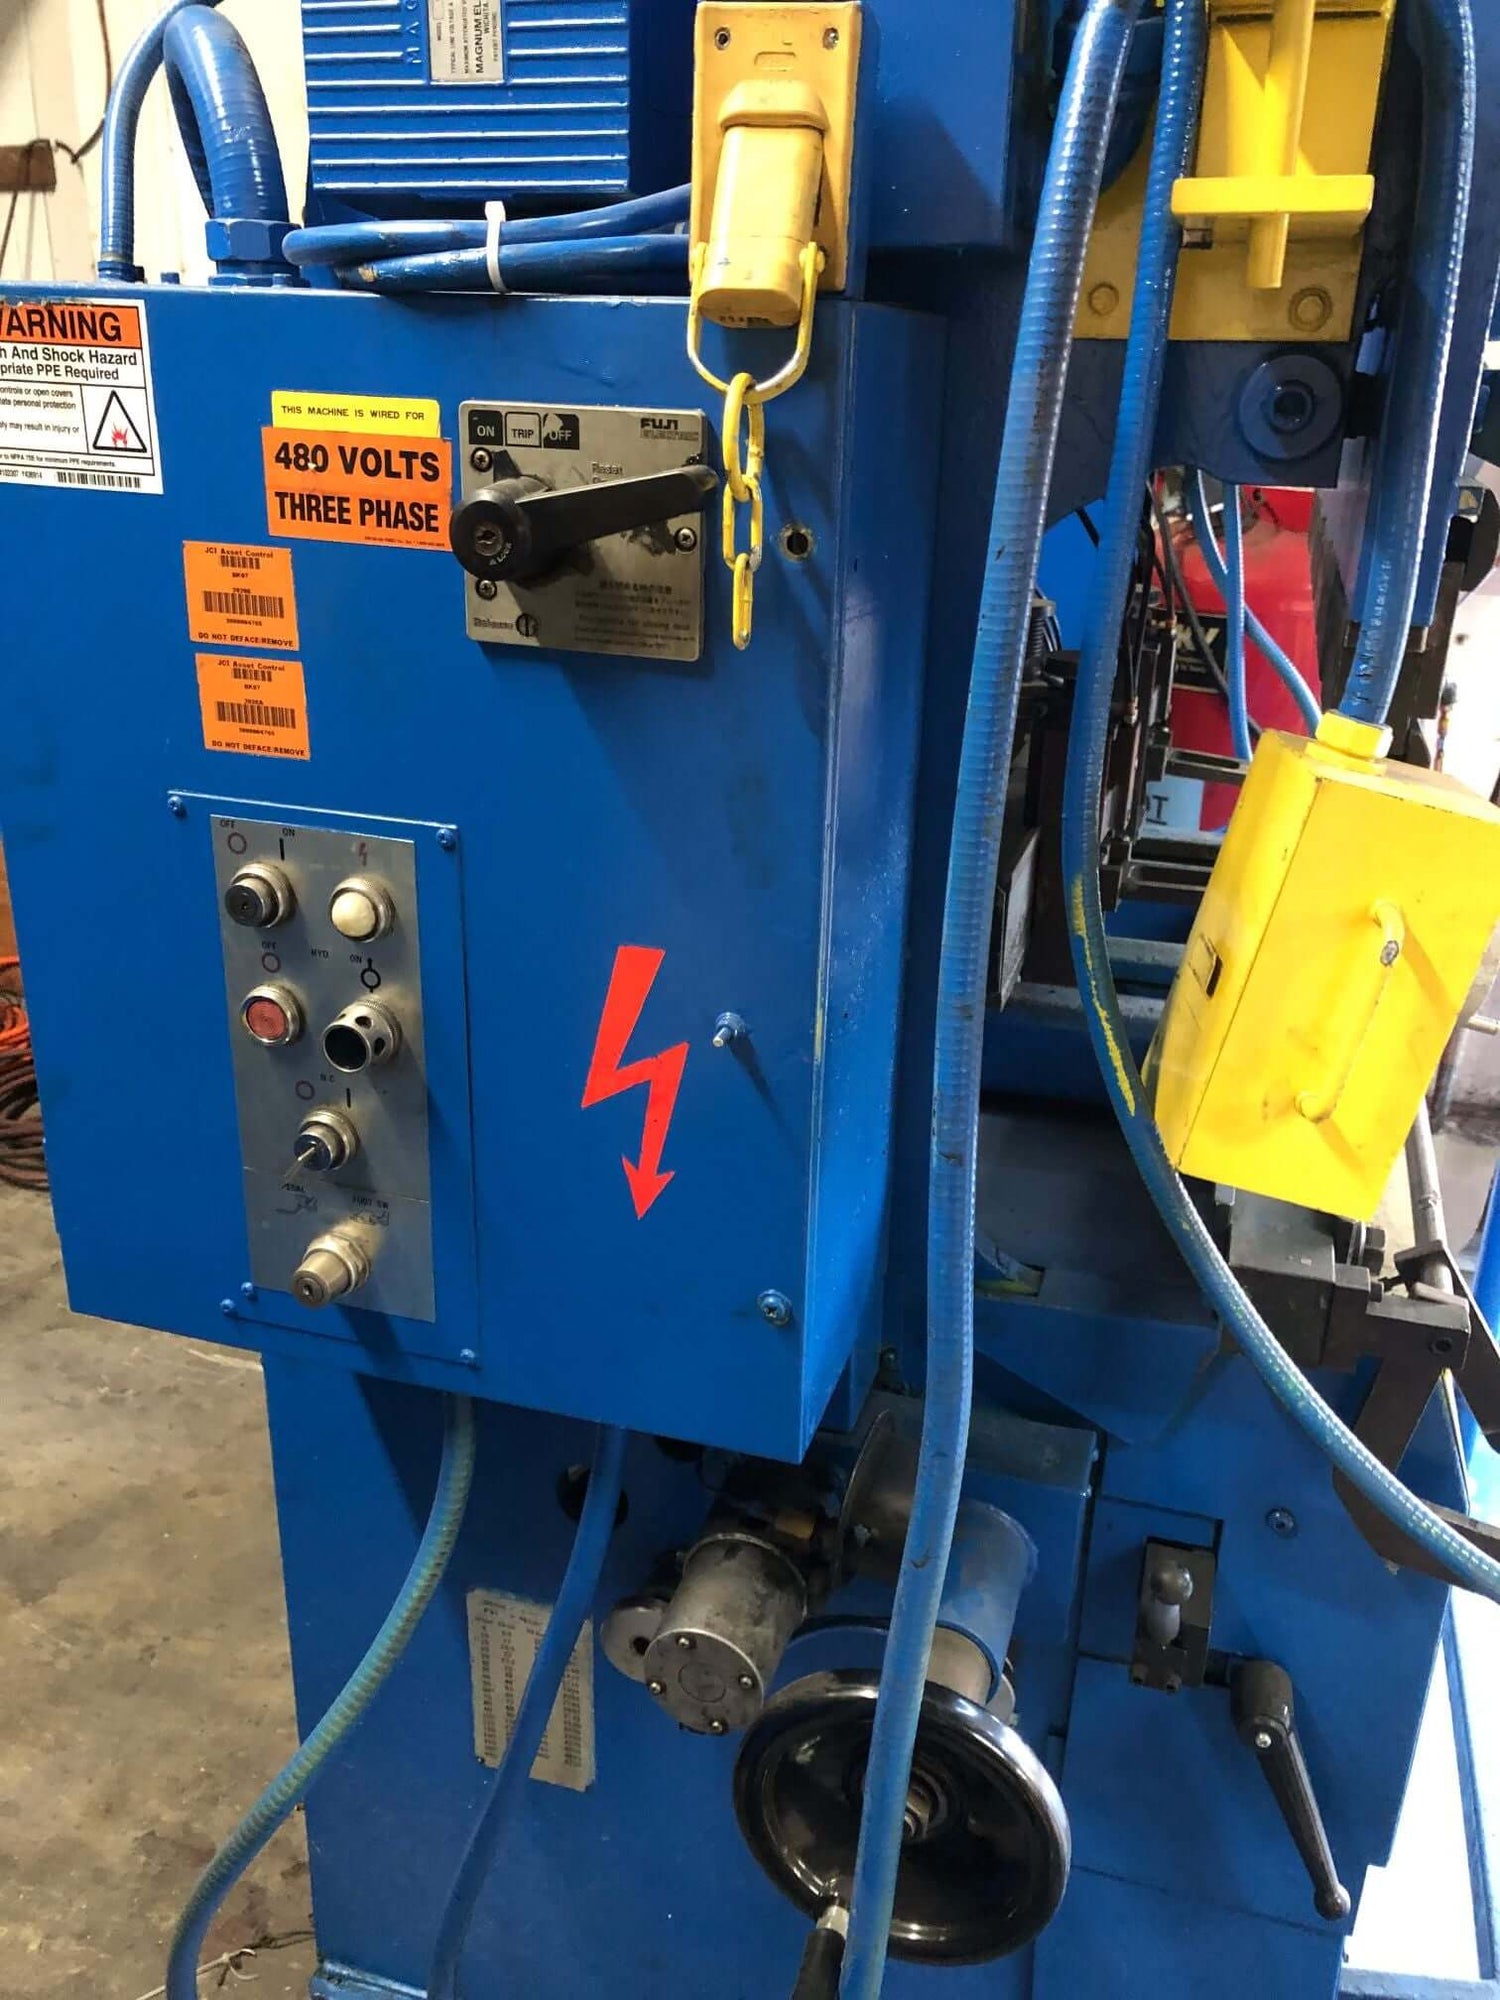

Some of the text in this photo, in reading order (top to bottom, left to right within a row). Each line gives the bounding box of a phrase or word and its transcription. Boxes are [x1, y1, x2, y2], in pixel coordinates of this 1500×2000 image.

[482, 2, 490, 34] WICHITA
[474, 18, 484, 73] MAGNUM
[0, 307, 122, 341] ARNING
[12, 346, 38, 360] And
[42, 347, 85, 363] Shock
[89, 349, 137, 365] Hazard
[37, 364, 61, 376] PPE
[64, 365, 119, 381] Required
[33, 388, 50, 397] open
[13, 399, 41, 408] personal
[42, 401, 76, 410] protection
[281, 405, 425, 421] THIS MACHINE IS WIRED FOR
[9, 422, 22, 432] may
[24, 423, 42, 431] result
[52, 424, 70, 434] injury
[640, 417, 678, 430] FUJI
[477, 425, 573, 441] ON TRIP OFF
[275, 442, 440, 482] 480 VOLTS
[274, 491, 439, 533] THREE PHASE
[245, 550, 274, 559] Control
[257, 663, 285, 671] Control
[220, 819, 295, 836] OFF ON
[261, 940, 277, 950] OFF
